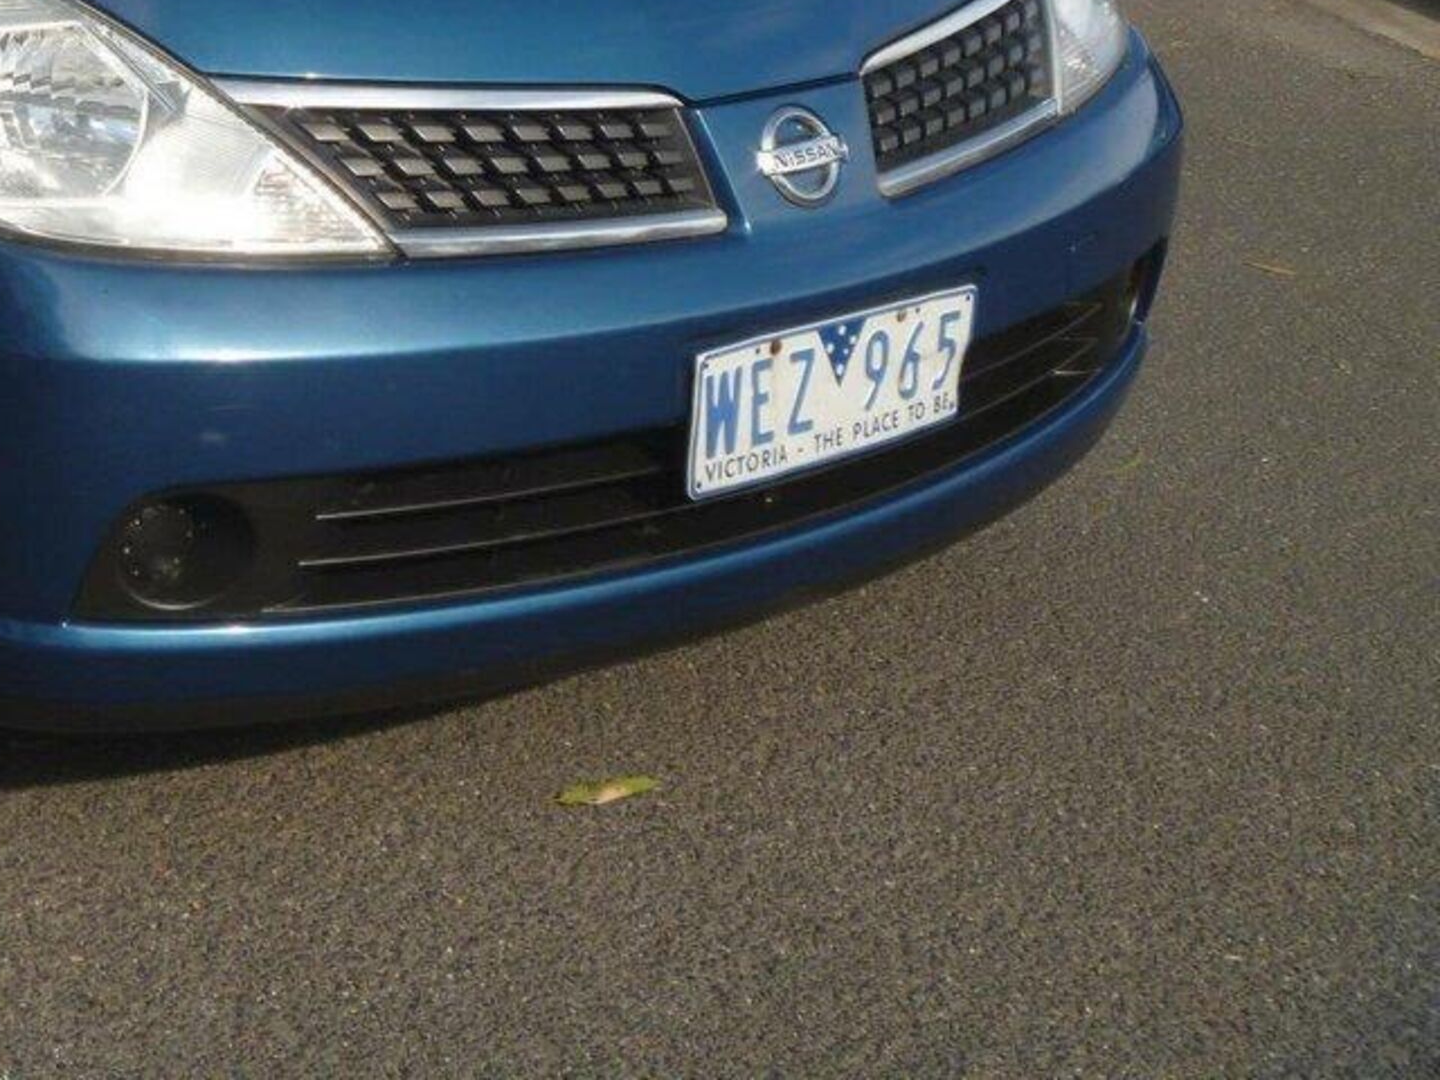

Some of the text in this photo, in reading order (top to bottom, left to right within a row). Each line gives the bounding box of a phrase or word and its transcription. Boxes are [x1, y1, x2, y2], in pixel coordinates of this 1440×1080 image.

[773, 144, 838, 169] NISSAN
[705, 310, 961, 460] WEZ 965
[705, 445, 788, 480] VICTORIA
[813, 430, 843, 454] THE
[852, 411, 899, 442] PLACE
[908, 402, 926, 420] TO
